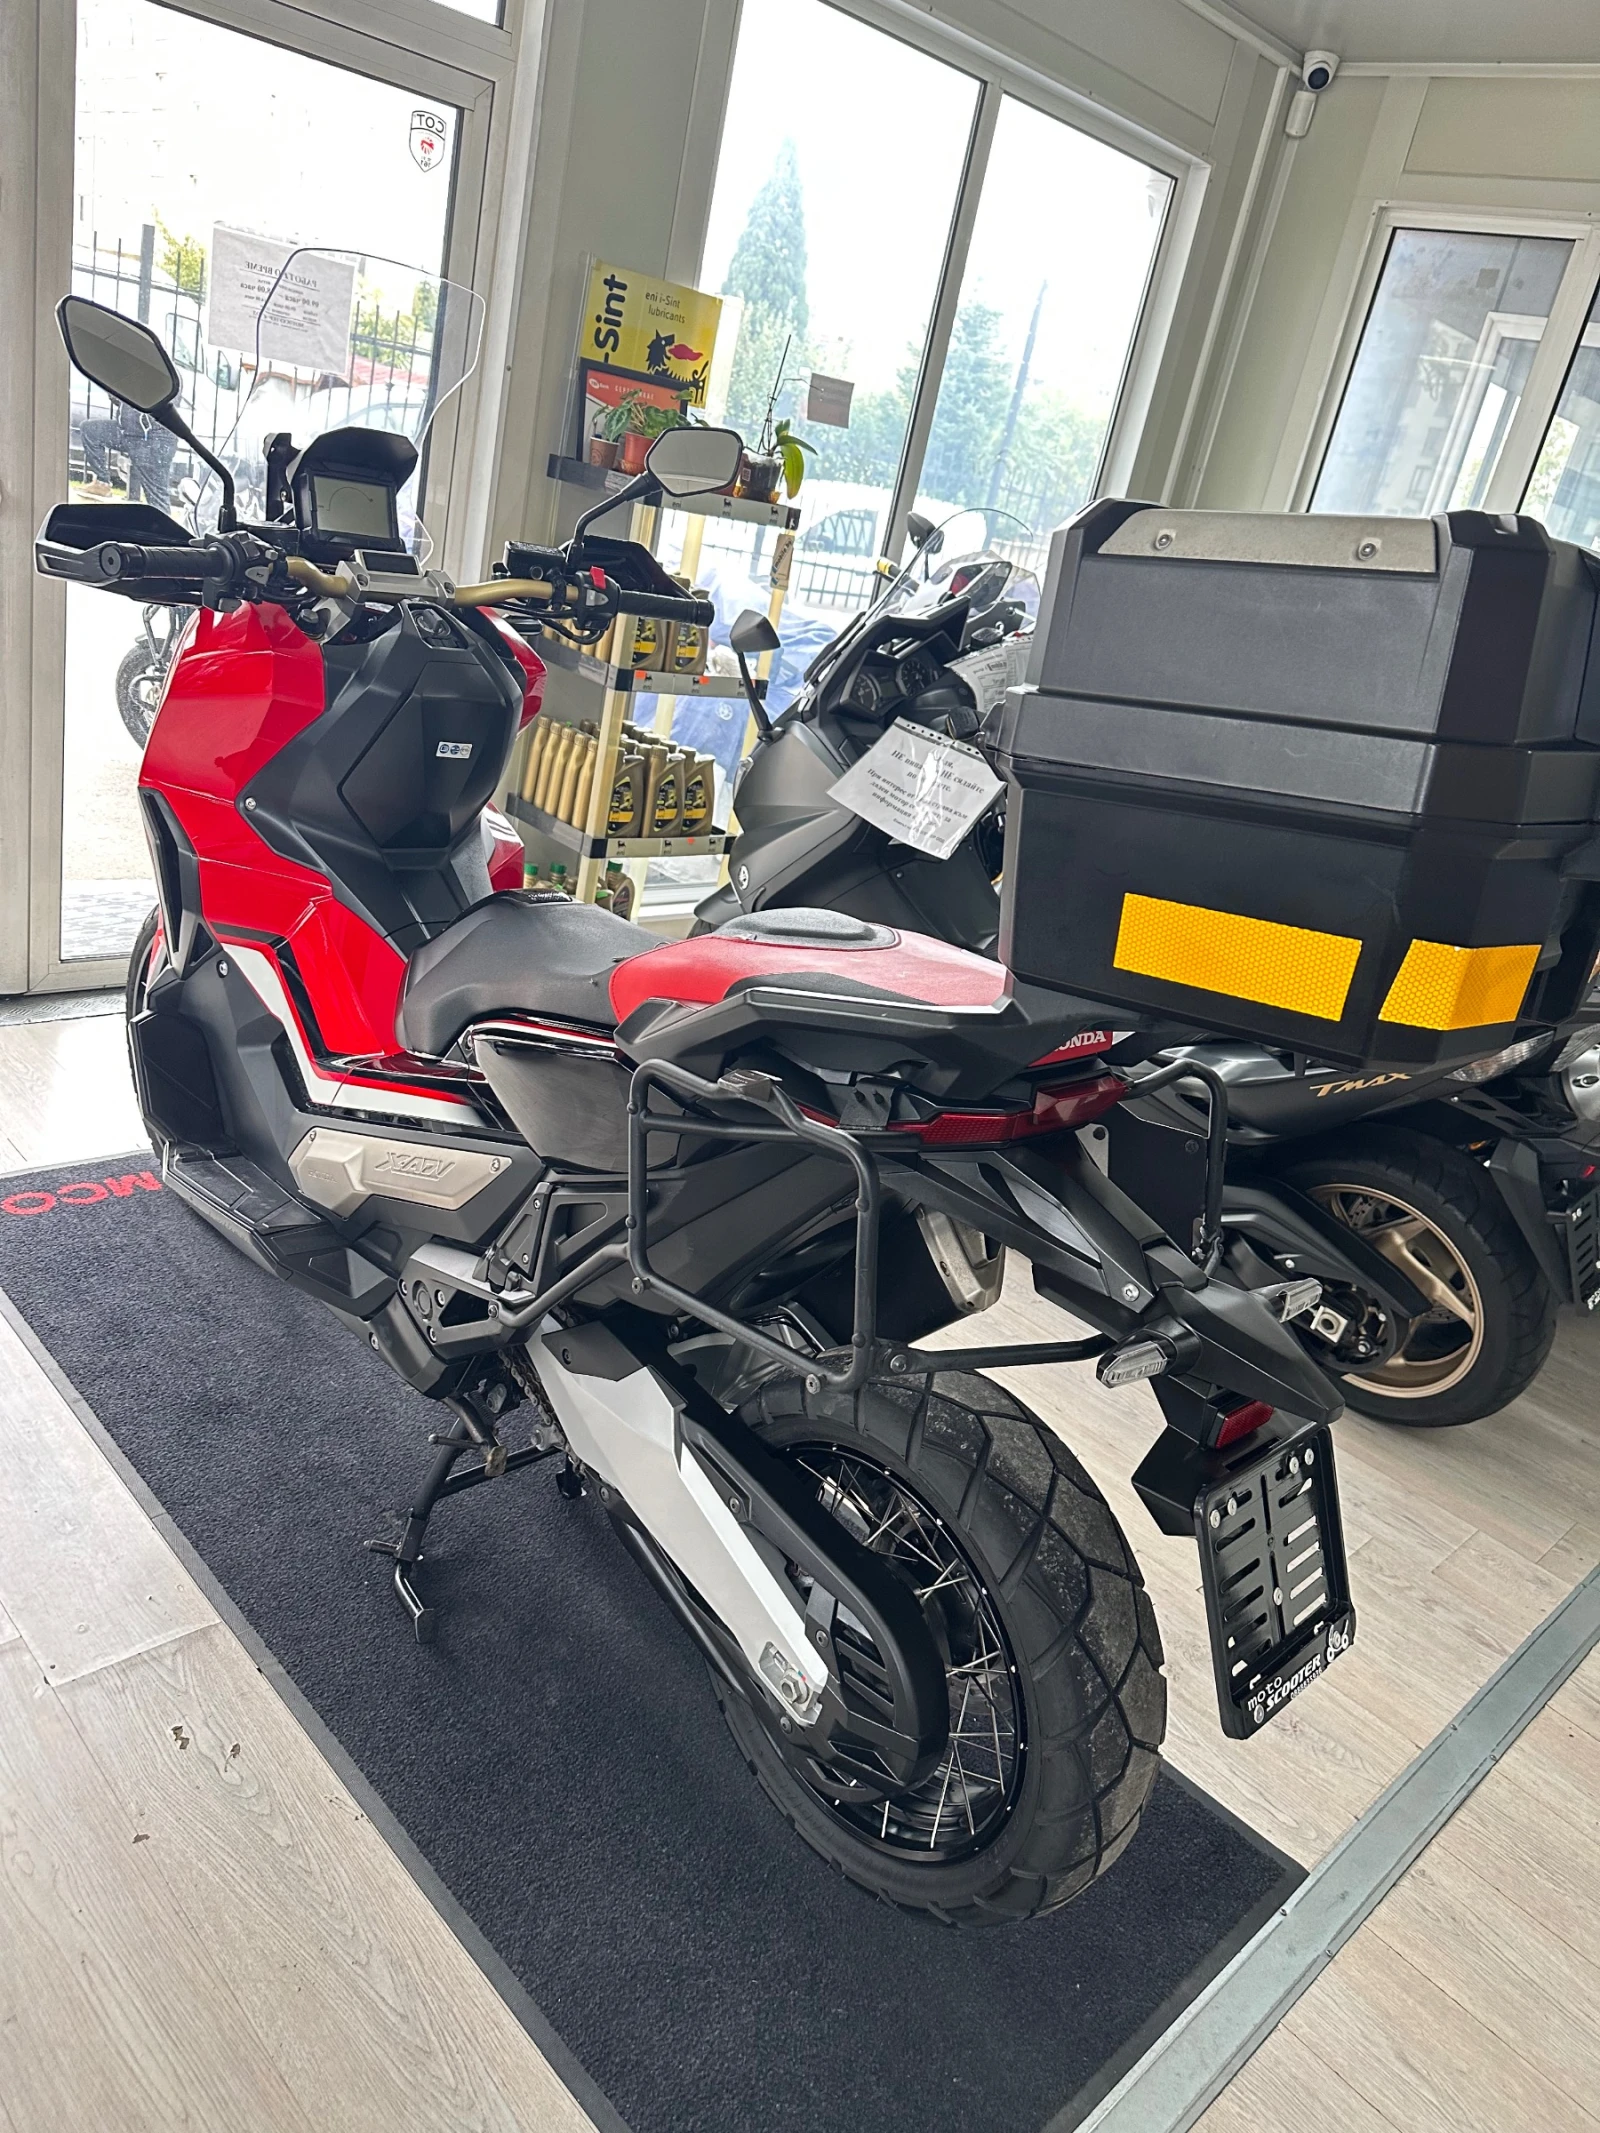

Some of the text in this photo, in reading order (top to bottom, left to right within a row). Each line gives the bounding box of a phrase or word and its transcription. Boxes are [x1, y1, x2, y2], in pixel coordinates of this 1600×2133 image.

[645, 291, 681, 310] eni i-Sint
[647, 304, 686, 325] lubricants
[594, 273, 628, 365] -Sint
[891, 750, 906, 761] НЕ
[941, 769, 955, 781] НЕ
[867, 768, 881, 780] При
[881, 776, 908, 794] интерес
[953, 811, 968, 820] към
[871, 791, 913, 817] информация
[889, 793, 909, 808] мотор
[1309, 1072, 1413, 1098] TMAX
[1247, 1675, 1283, 1711] moto
[1266, 1653, 1321, 1712] SCOOTER
